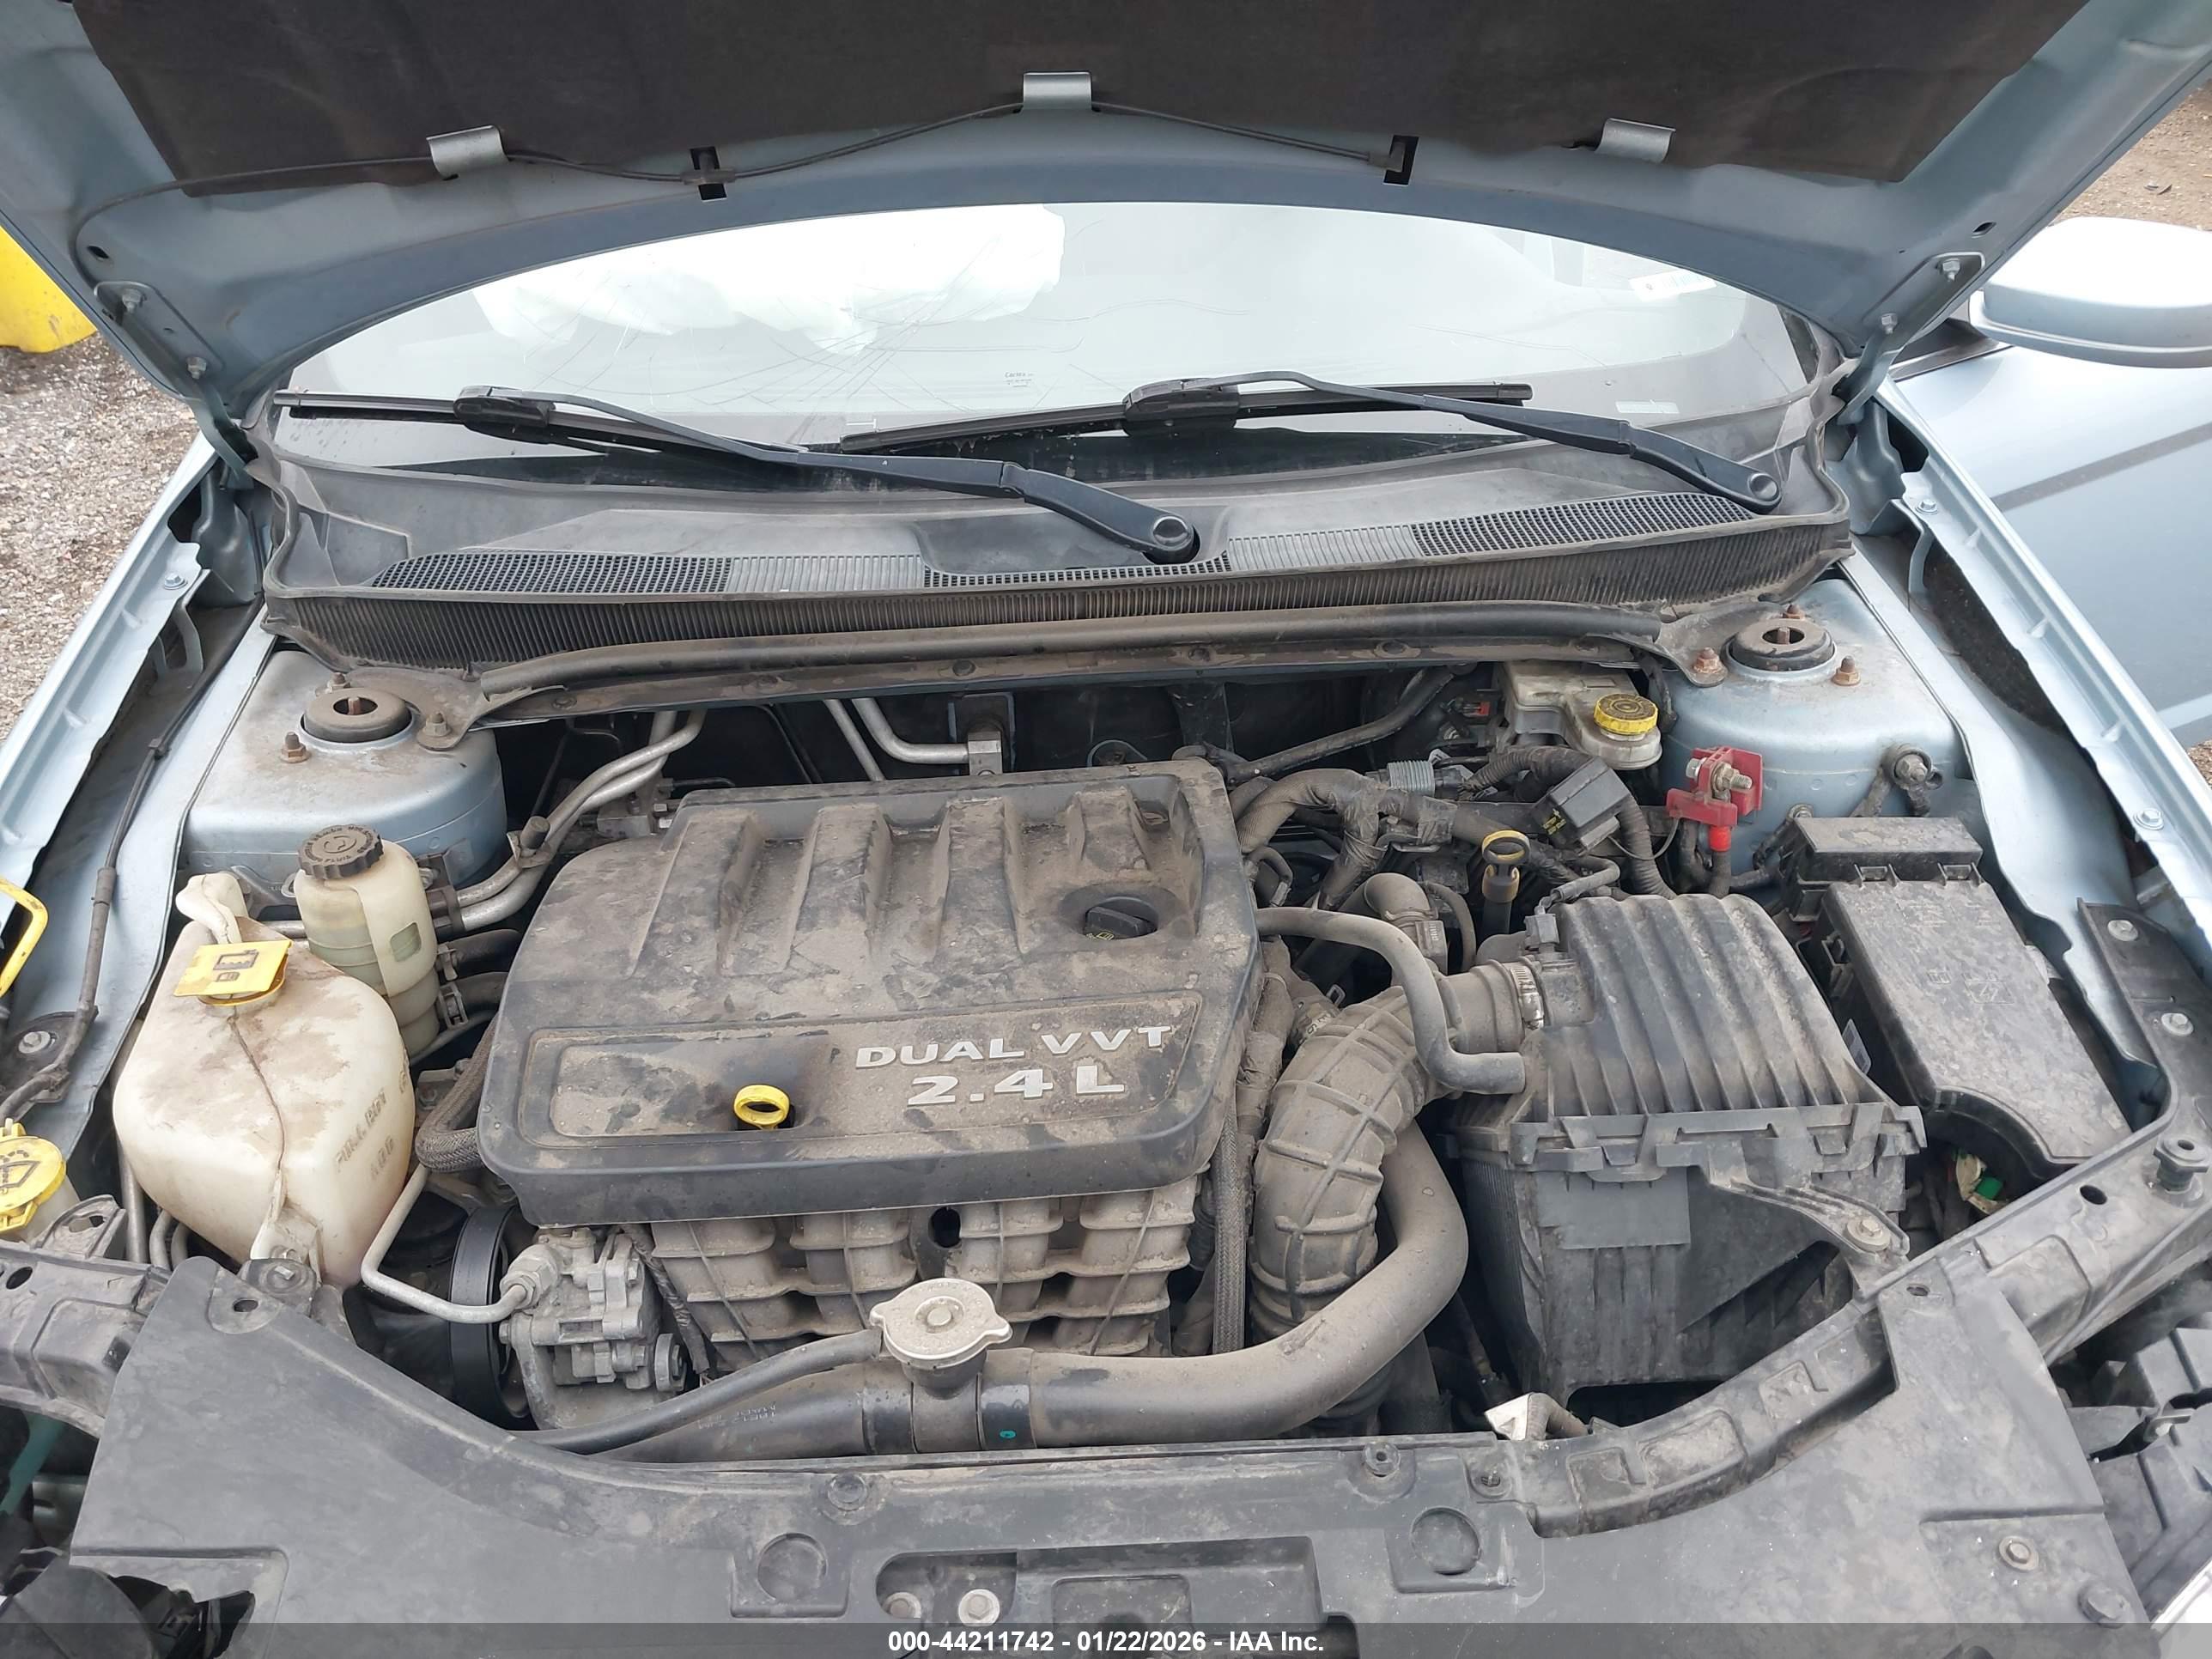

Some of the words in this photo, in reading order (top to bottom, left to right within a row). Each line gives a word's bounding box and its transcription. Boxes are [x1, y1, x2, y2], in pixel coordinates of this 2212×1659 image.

[855, 1038, 1025, 1068] DUAL
[1041, 1025, 1172, 1055] VVT
[907, 1068, 1054, 1107] 2.4
[1076, 1064, 1126, 1095] L
